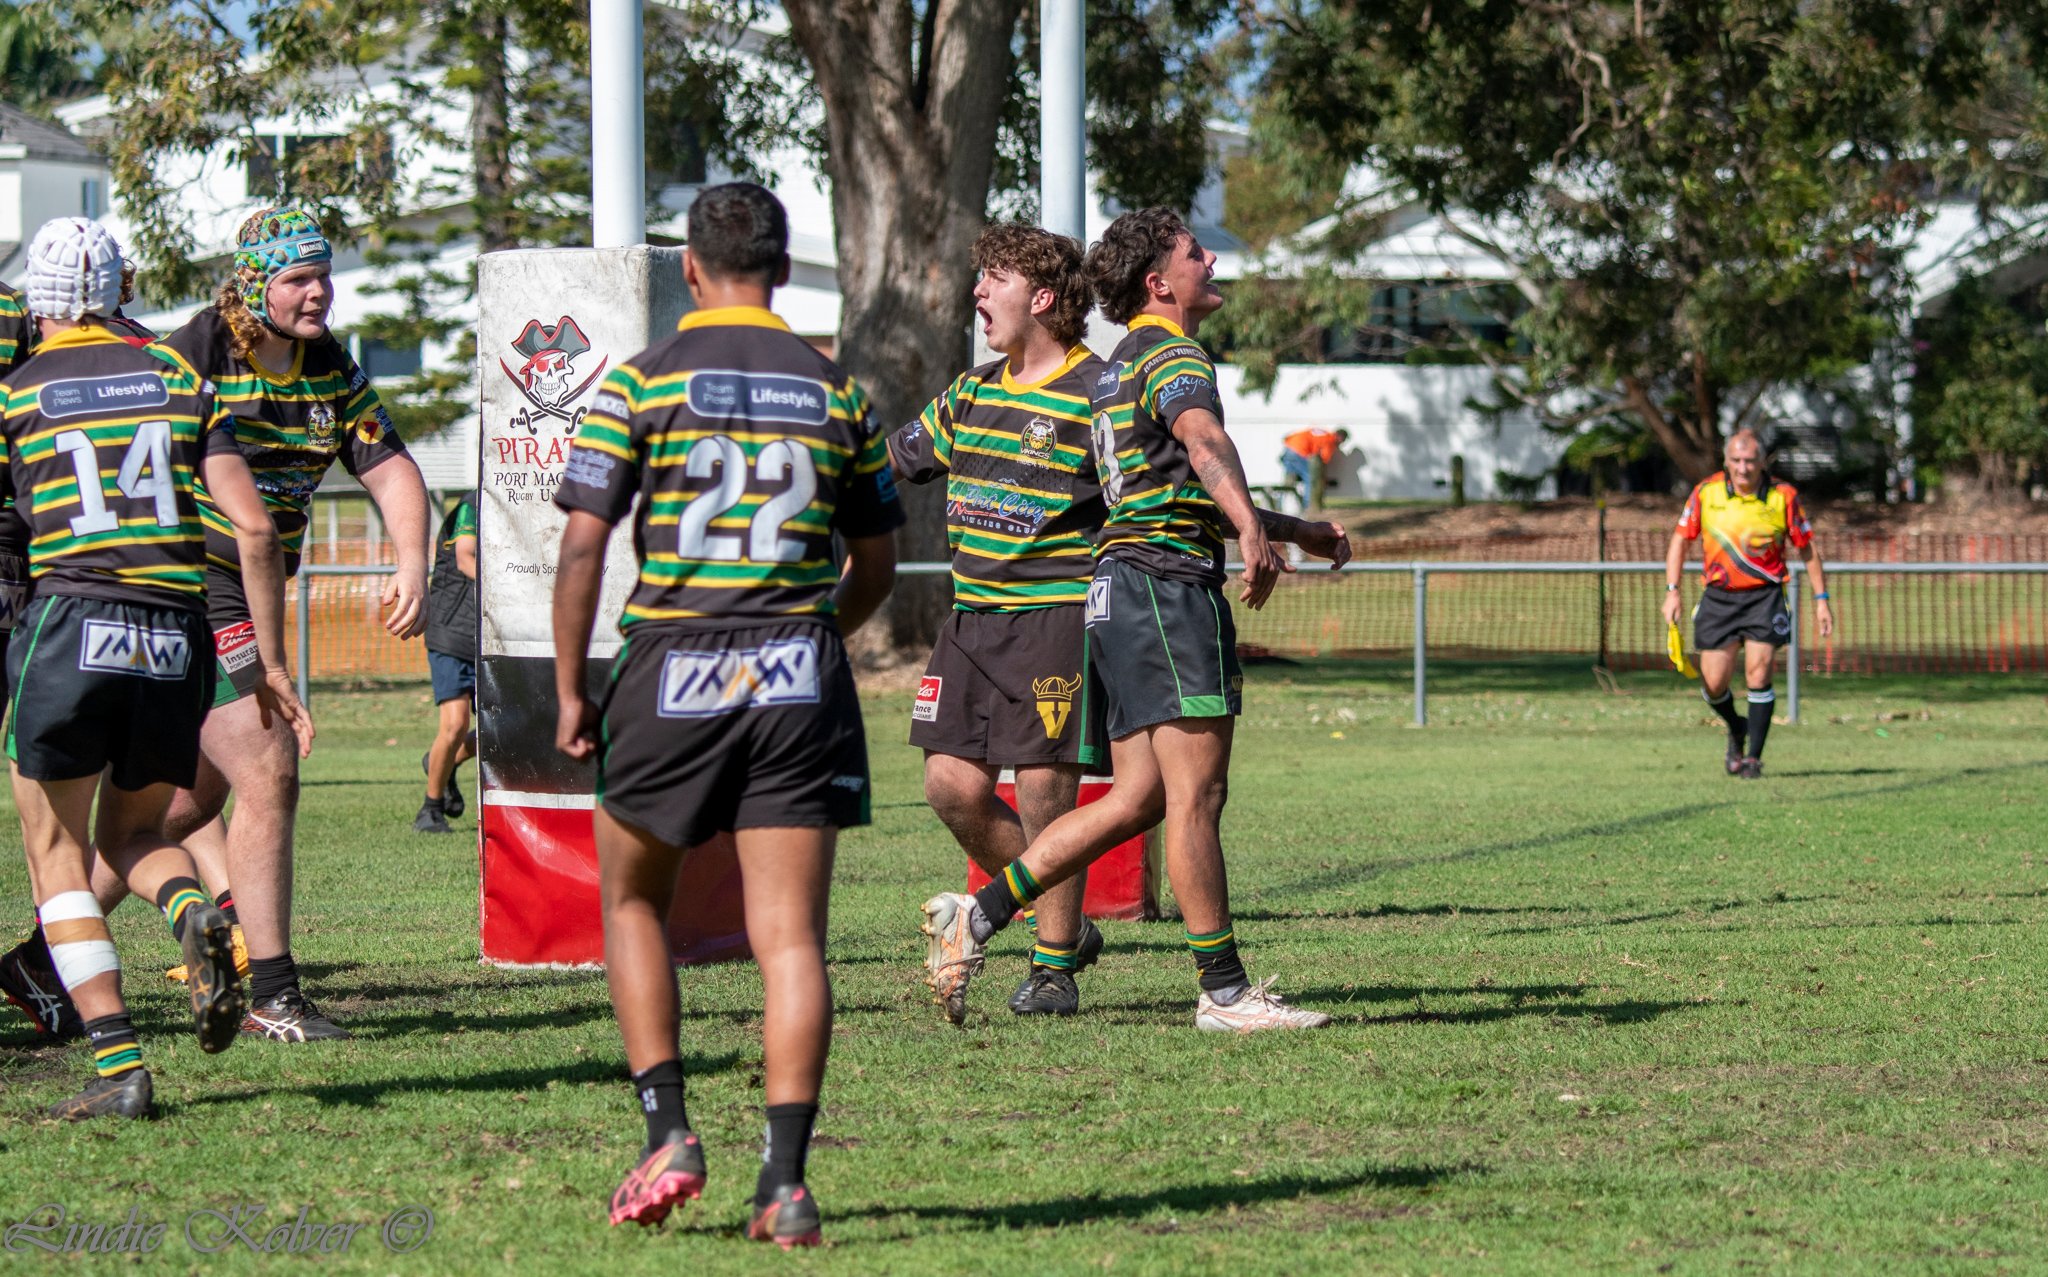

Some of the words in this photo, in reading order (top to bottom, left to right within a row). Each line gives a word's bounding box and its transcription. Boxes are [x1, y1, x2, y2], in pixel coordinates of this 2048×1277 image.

[53, 388, 80, 398] Team
[97, 382, 161, 398] Lifestyle.
[704, 382, 735, 394] Team
[751, 388, 820, 409] Lifestyle.
[492, 436, 574, 469] PIRAT
[1021, 448, 1050, 459] VIKINGS
[55, 420, 181, 537] 14
[494, 472, 528, 489] PORT
[678, 435, 817, 562] 22
[962, 485, 998, 509] Port
[998, 492, 1046, 524] City
[505, 562, 541, 575] Proudly
[1036, 702, 1072, 739] V
